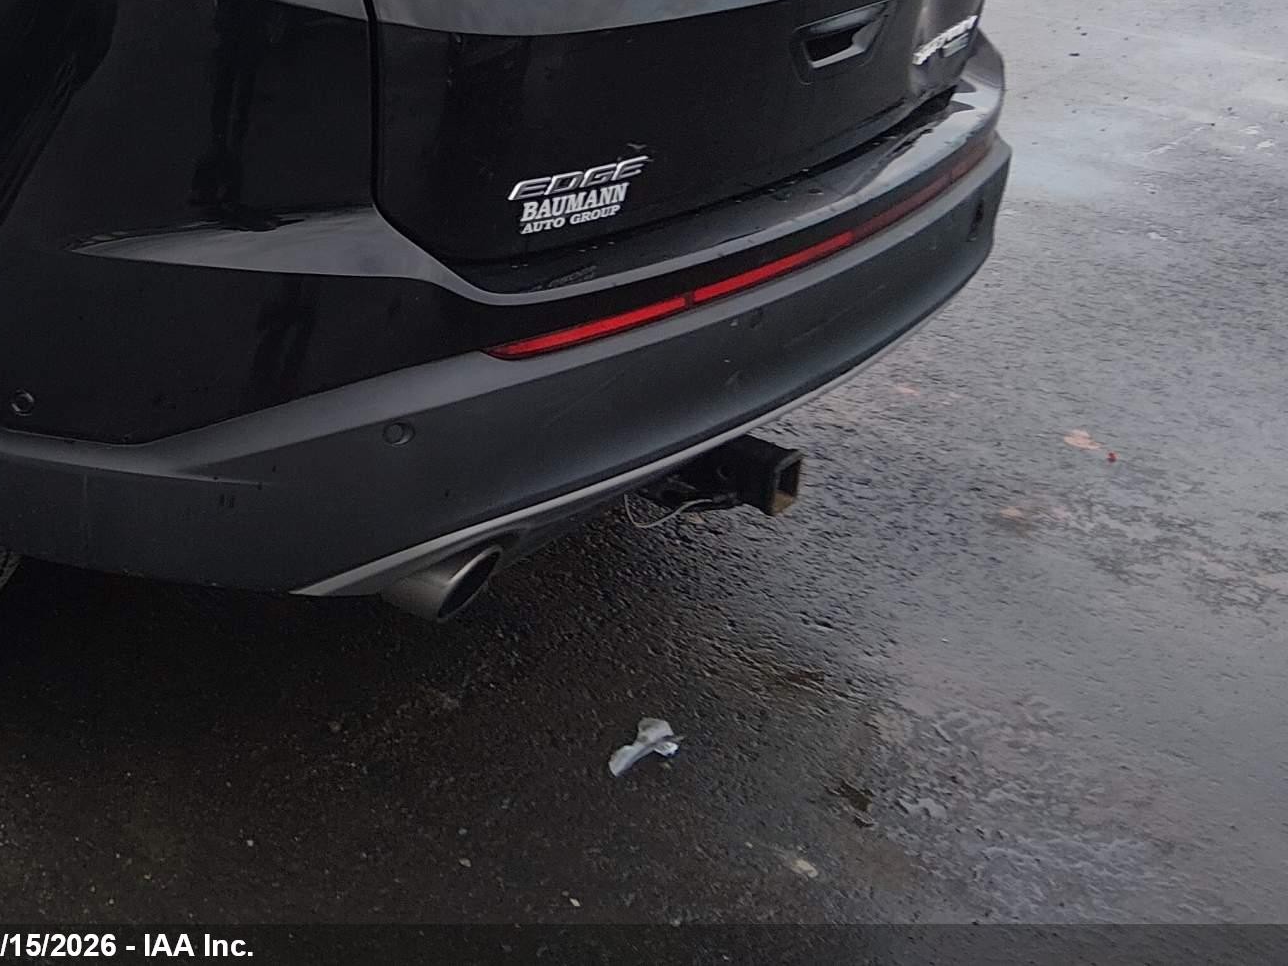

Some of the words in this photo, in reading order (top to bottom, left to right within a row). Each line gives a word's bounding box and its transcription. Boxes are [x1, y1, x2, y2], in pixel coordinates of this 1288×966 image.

[508, 155, 649, 200] EDGE
[520, 182, 630, 222] BAUMANN
[520, 216, 566, 234] AUTO
[569, 204, 621, 224] GROUP
